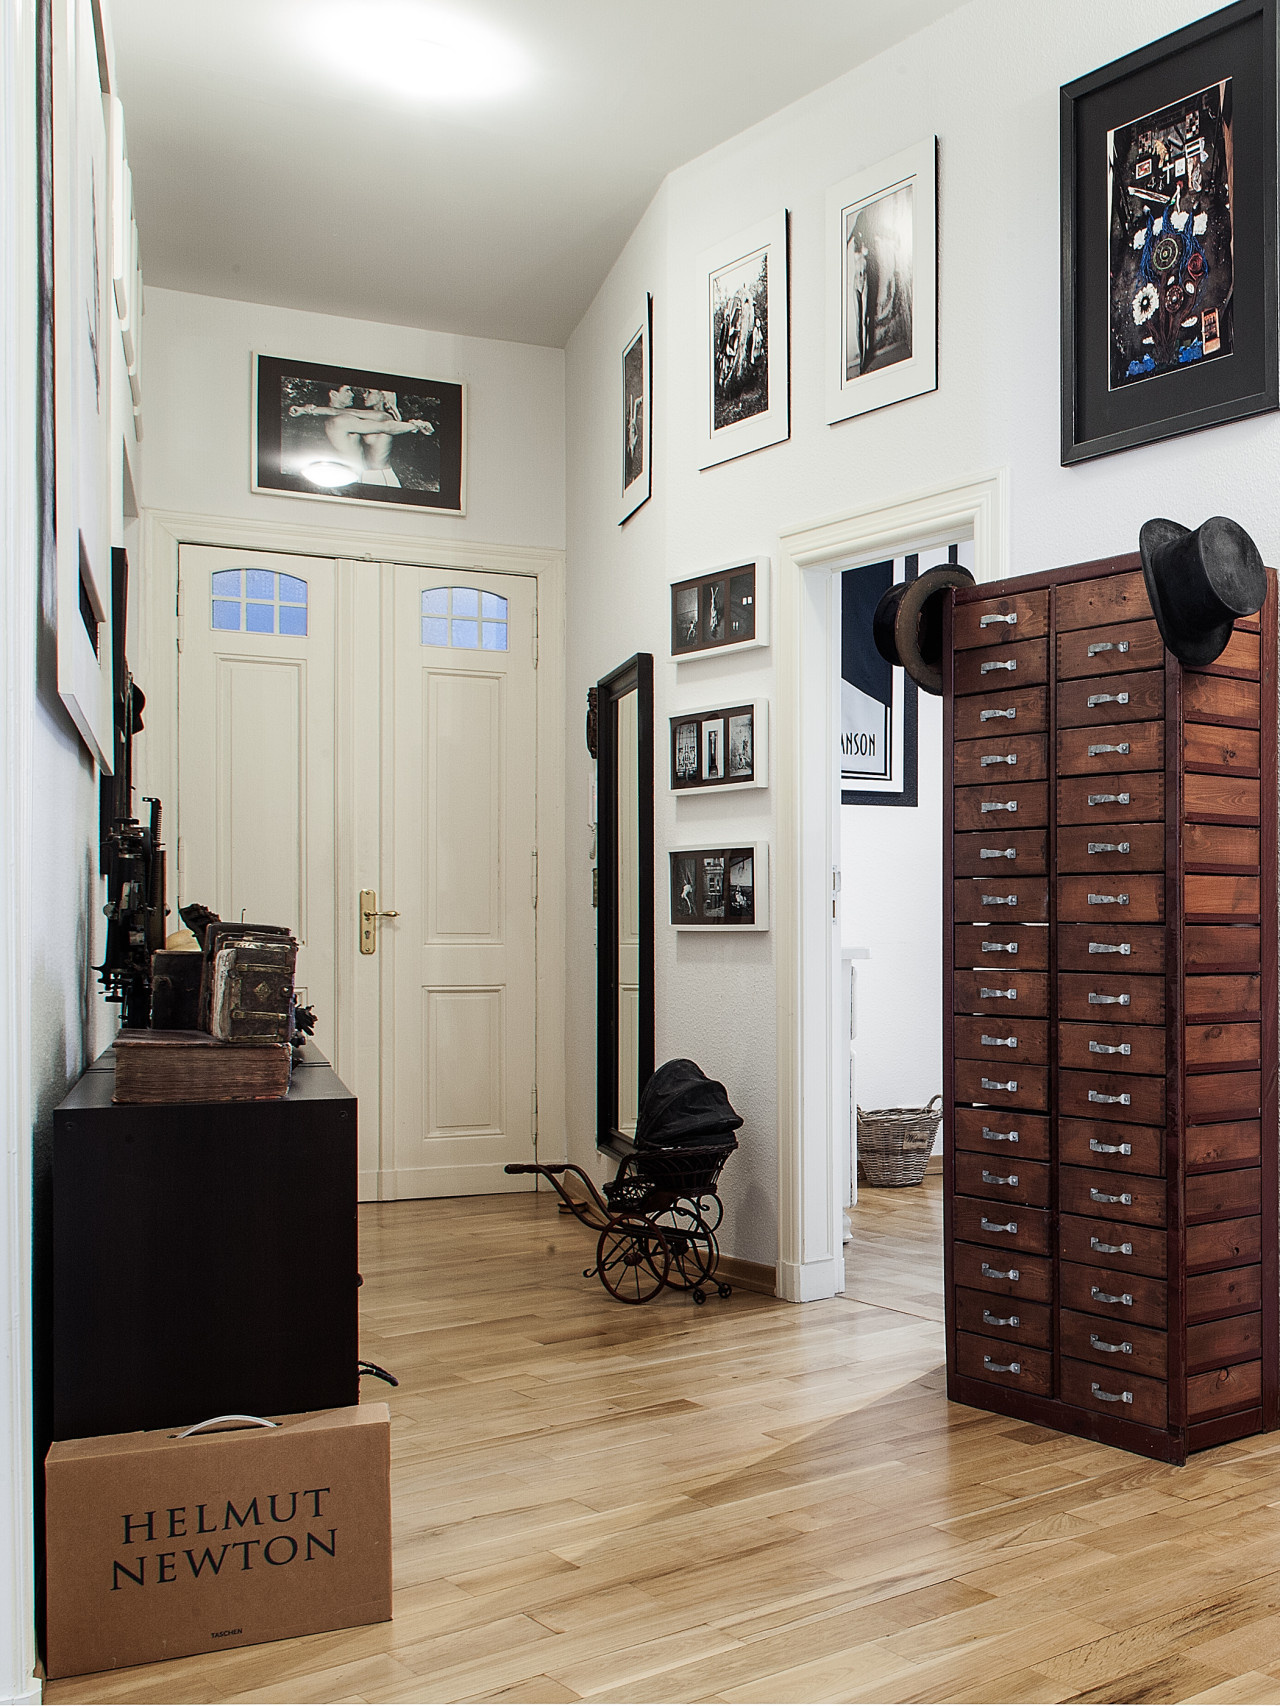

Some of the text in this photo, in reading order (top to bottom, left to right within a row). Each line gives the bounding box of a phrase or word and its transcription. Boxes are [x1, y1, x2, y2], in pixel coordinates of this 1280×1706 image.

[121, 1487, 331, 1545] HELMUT
[110, 1528, 338, 1591] NEWTON
[211, 1628, 243, 1639] TASCHEN
